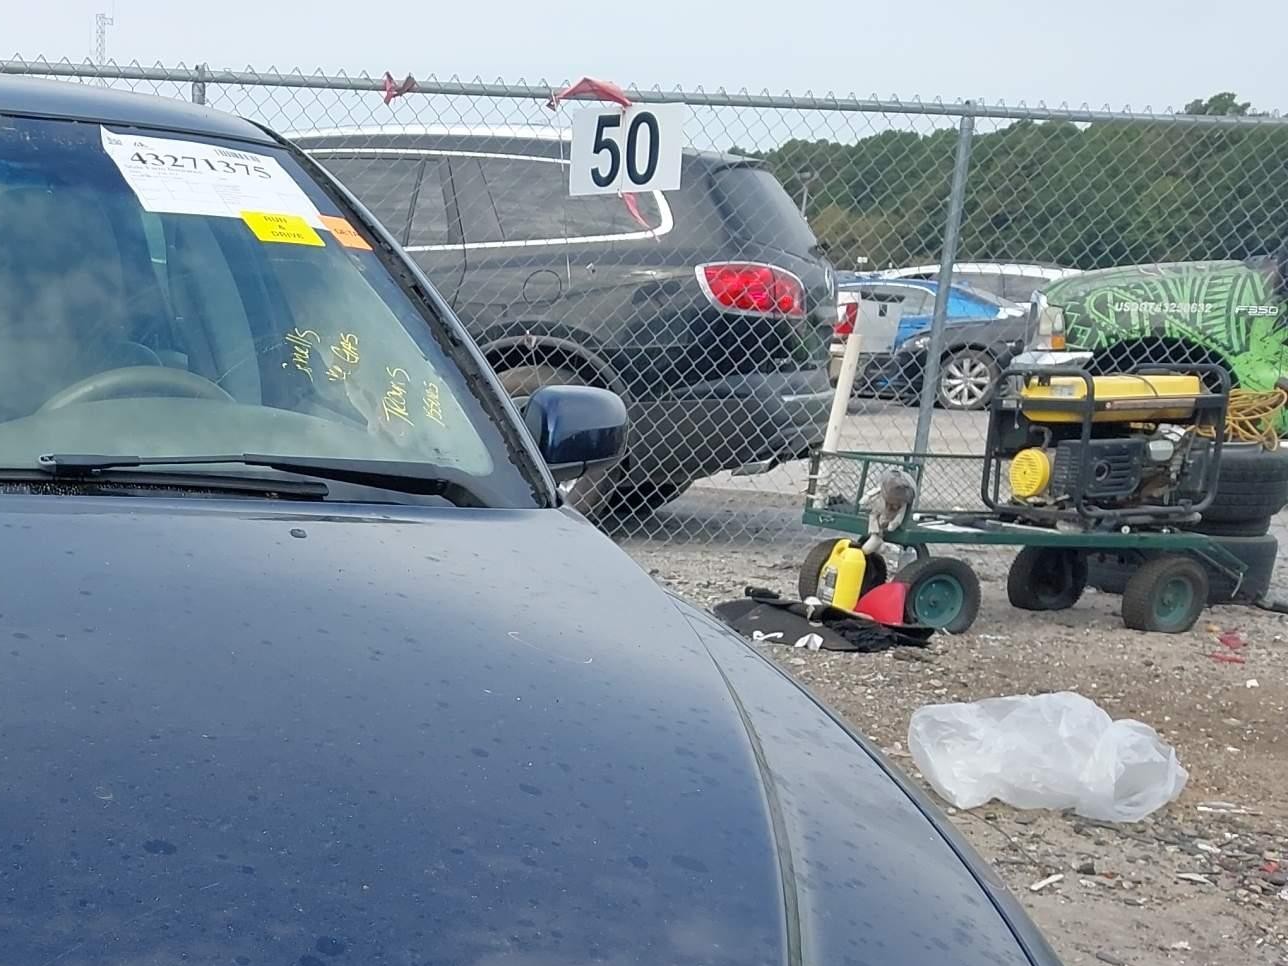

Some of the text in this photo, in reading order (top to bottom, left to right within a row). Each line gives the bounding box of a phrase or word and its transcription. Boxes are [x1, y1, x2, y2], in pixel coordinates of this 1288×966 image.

[590, 111, 660, 188] 50
[130, 151, 272, 180] 43271375
[1234, 305, 1279, 316] F350
